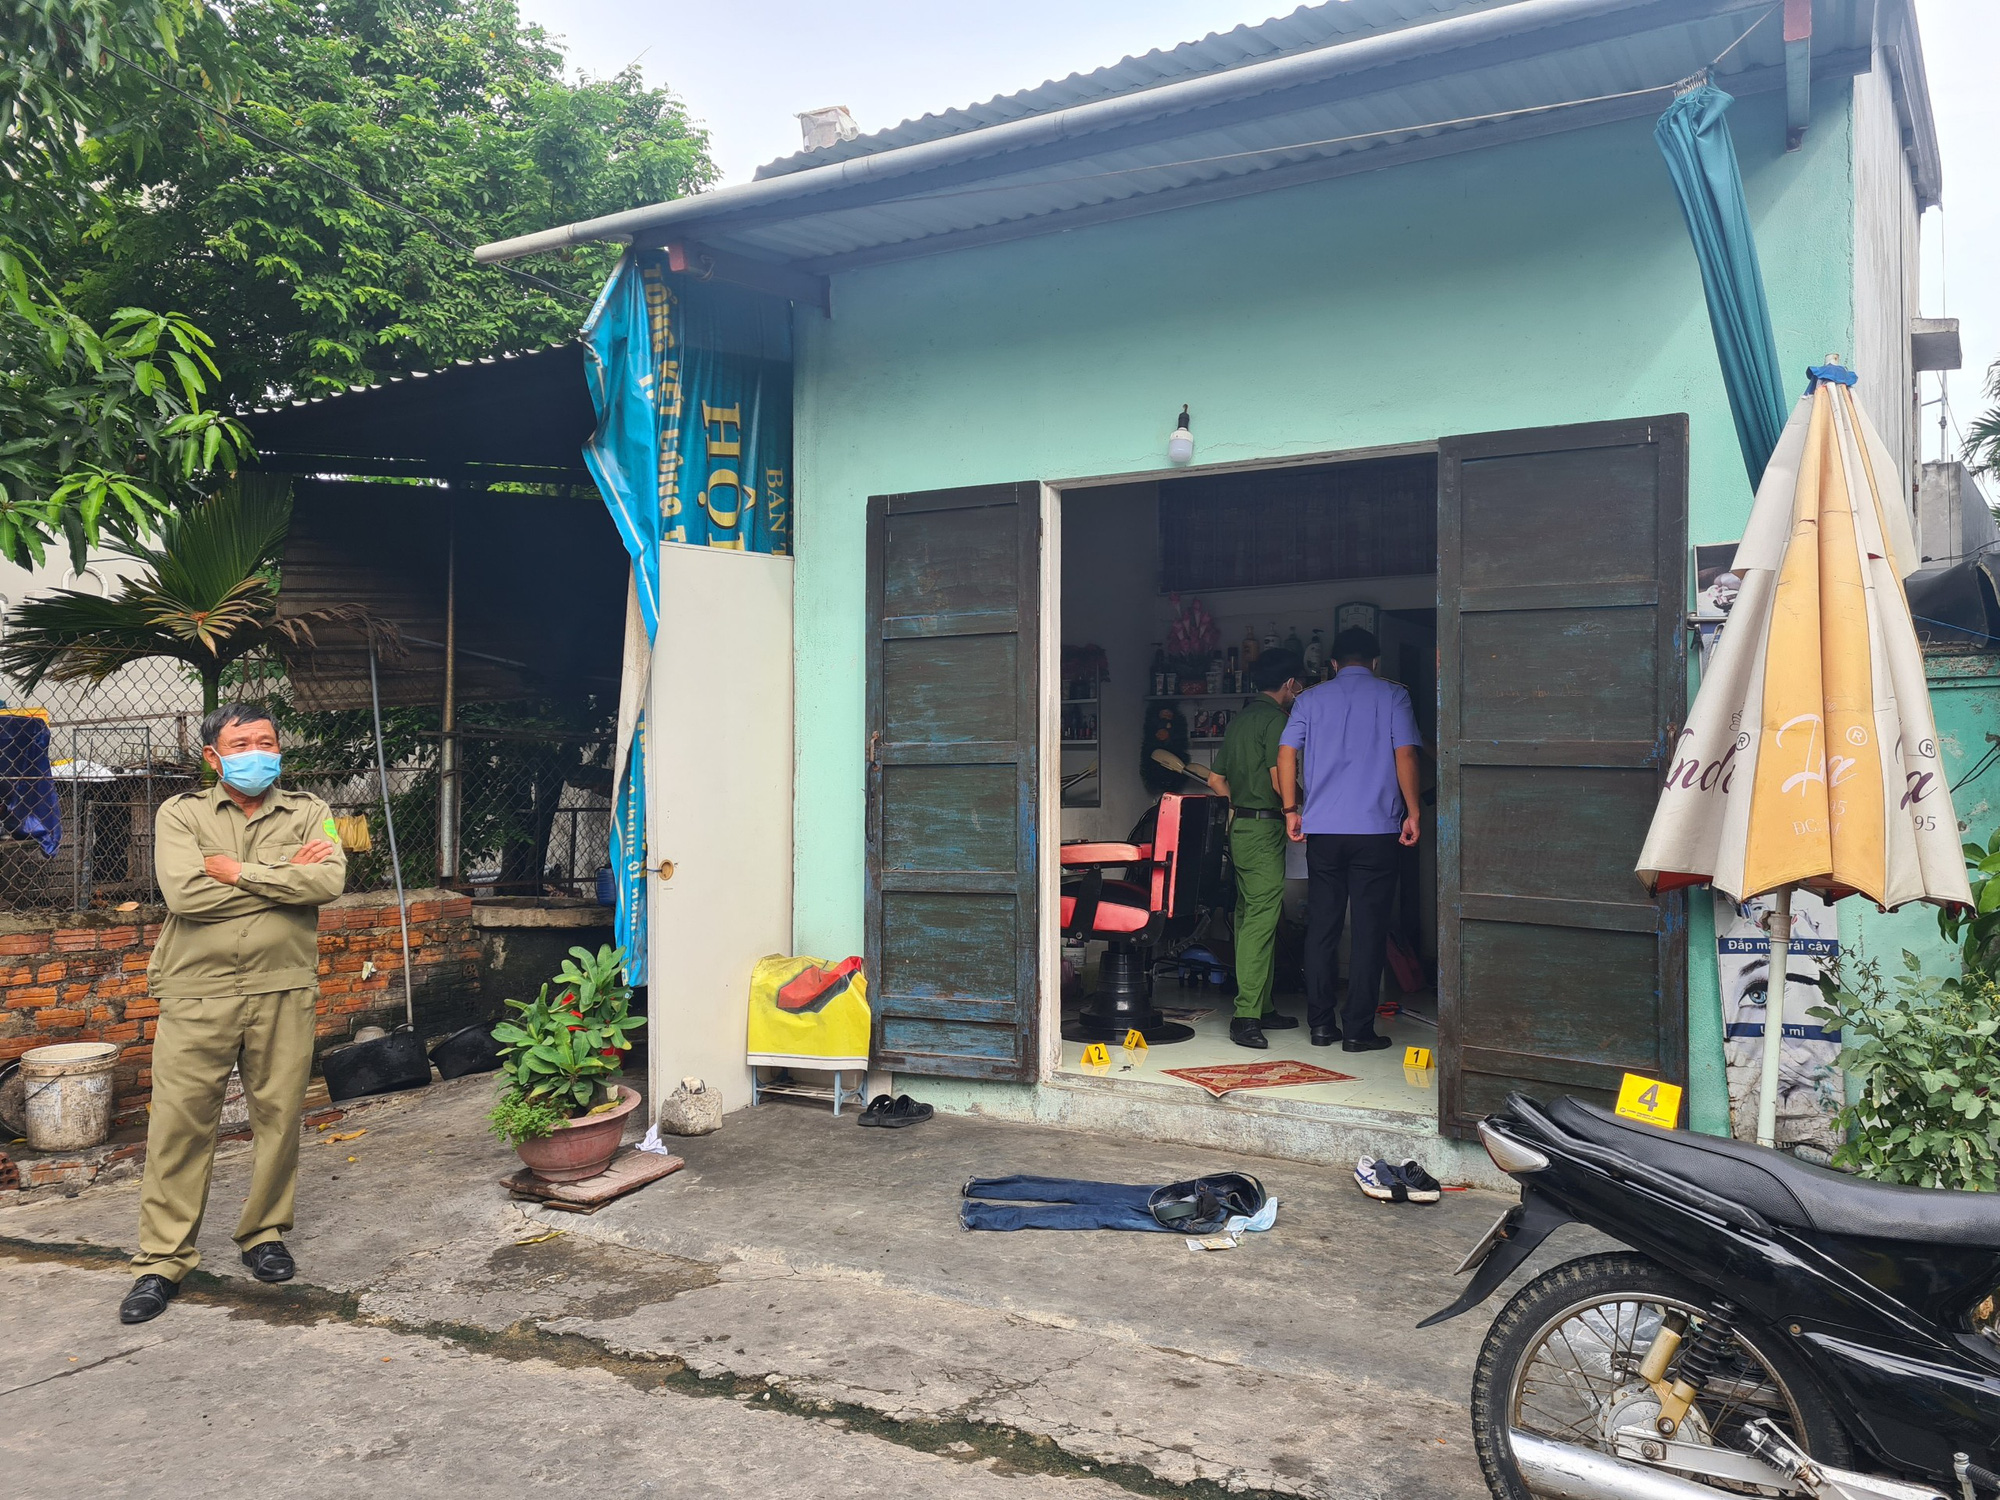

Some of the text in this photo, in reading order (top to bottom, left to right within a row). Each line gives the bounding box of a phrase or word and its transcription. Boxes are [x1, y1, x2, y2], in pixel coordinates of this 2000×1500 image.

[765, 467, 786, 533] BAN
[1128, 1032, 1136, 1045] 3
[1095, 1046, 1104, 1060] 2
[1414, 1049, 1420, 1064] 1
[1638, 1084, 1659, 1112] 4
